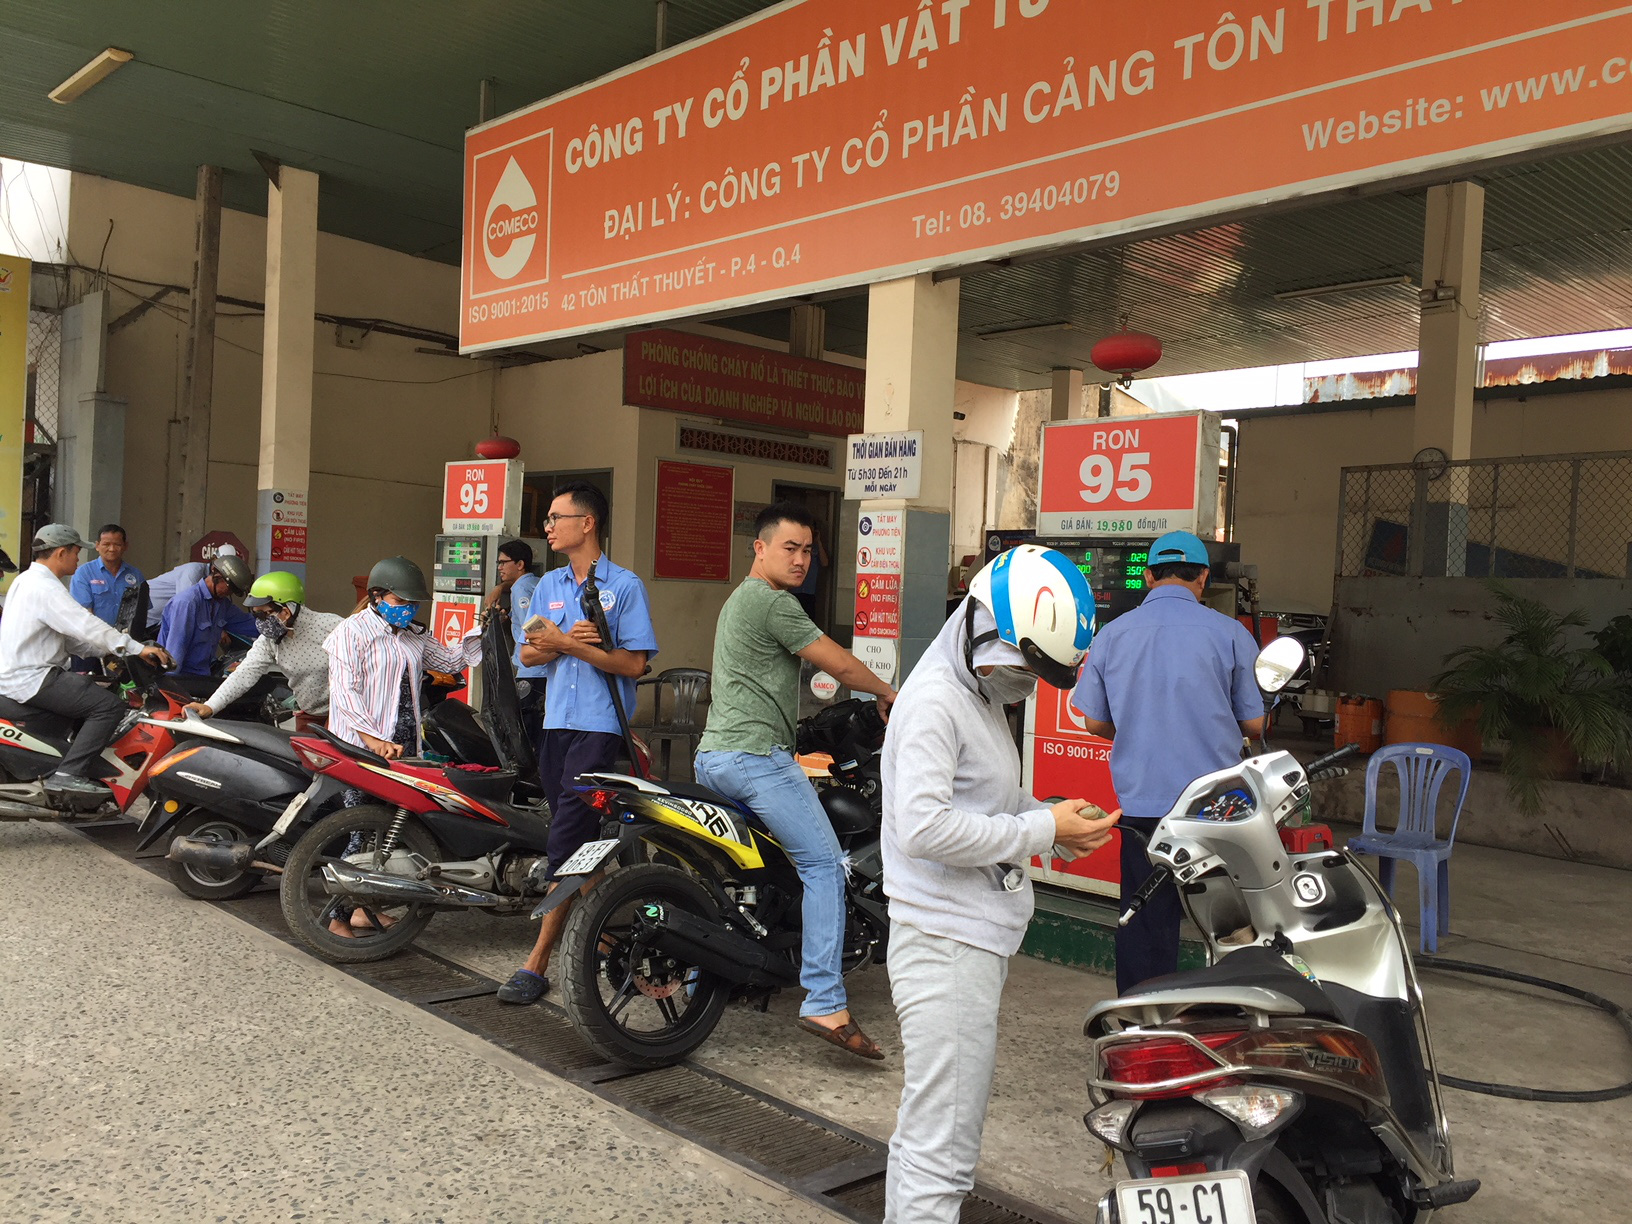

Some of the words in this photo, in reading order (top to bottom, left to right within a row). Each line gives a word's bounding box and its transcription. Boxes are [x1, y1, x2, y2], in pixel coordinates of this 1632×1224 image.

[565, 117, 643, 174] CÔNG
[653, 97, 694, 145] TY
[703, 56, 750, 129] CỔ
[760, 27, 866, 110] PHẦN
[880, 0, 970, 69] VẬT
[1301, 95, 1464, 151] Website:
[1480, 56, 1632, 112] www.c
[604, 201, 643, 240] ĐẠI
[651, 182, 690, 227] LÝ:
[700, 166, 781, 214] CÔNG
[792, 146, 831, 188] TY
[841, 109, 890, 175] CỔ
[902, 86, 1008, 159] PHẦN
[1023, 49, 1155, 124] CẢNG
[1174, 8, 1286, 81] TÔN
[912, 210, 951, 238] Tel:
[959, 202, 992, 229] 08.
[1000, 170, 1120, 220] 39404079
[488, 211, 538, 240] COMECO
[561, 293, 576, 311] 42
[579, 284, 607, 308] TÔN
[611, 268, 649, 302] THẤT
[654, 256, 716, 293] THUYẾT
[731, 253, 756, 277] P.4
[772, 243, 801, 268] Q.4
[468, 303, 488, 323] ISO
[490, 291, 549, 320] 9001:2015
[641, 338, 679, 366] PHÒNG
[682, 344, 718, 373] CHỐNG
[721, 354, 748, 378] CHÁY
[751, 355, 765, 381] NỔ
[767, 361, 779, 384] LÀ
[782, 364, 808, 390] THIẾT
[810, 374, 835, 398] THỰC
[837, 374, 855, 399] BẢO
[640, 373, 657, 400] LỢI
[660, 373, 678, 399] ÍCH
[681, 376, 702, 404] CỦA
[705, 386, 740, 410] DOANH
[743, 393, 778, 420] NGHIỆP
[781, 396, 793, 418] VÀ
[796, 400, 824, 424] NGƯỜI
[826, 408, 843, 427] LAO
[852, 438, 867, 459] THỜI
[868, 441, 883, 459] GIAN
[884, 437, 897, 458] BÁN
[899, 436, 916, 458] HÀNG
[1092, 429, 1140, 450] RON
[466, 469, 485, 481] RON
[848, 468, 857, 480] Từ
[858, 468, 876, 480] 5h30
[878, 465, 892, 480] Đến
[894, 466, 908, 478] 21h
[1079, 452, 1152, 503] 95
[879, 482, 897, 492] NGÀY
[460, 483, 489, 514] 95
[1061, 517, 1073, 530] GIÁ
[1076, 517, 1093, 530] BÁN:
[1097, 520, 1133, 532] 19.980
[1137, 516, 1167, 531] đồng/lít
[870, 575, 885, 589] CẤM
[885, 576, 898, 590] LỬA
[1125, 579, 1142, 589] 998
[871, 594, 881, 603] (NO
[882, 594, 897, 604] FIRE)
[866, 645, 882, 653] CHO
[875, 661, 891, 671] KHO
[813, 680, 835, 690] SAMCO
[0, 727, 23, 741] OL
[1043, 742, 1064, 756] ISO
